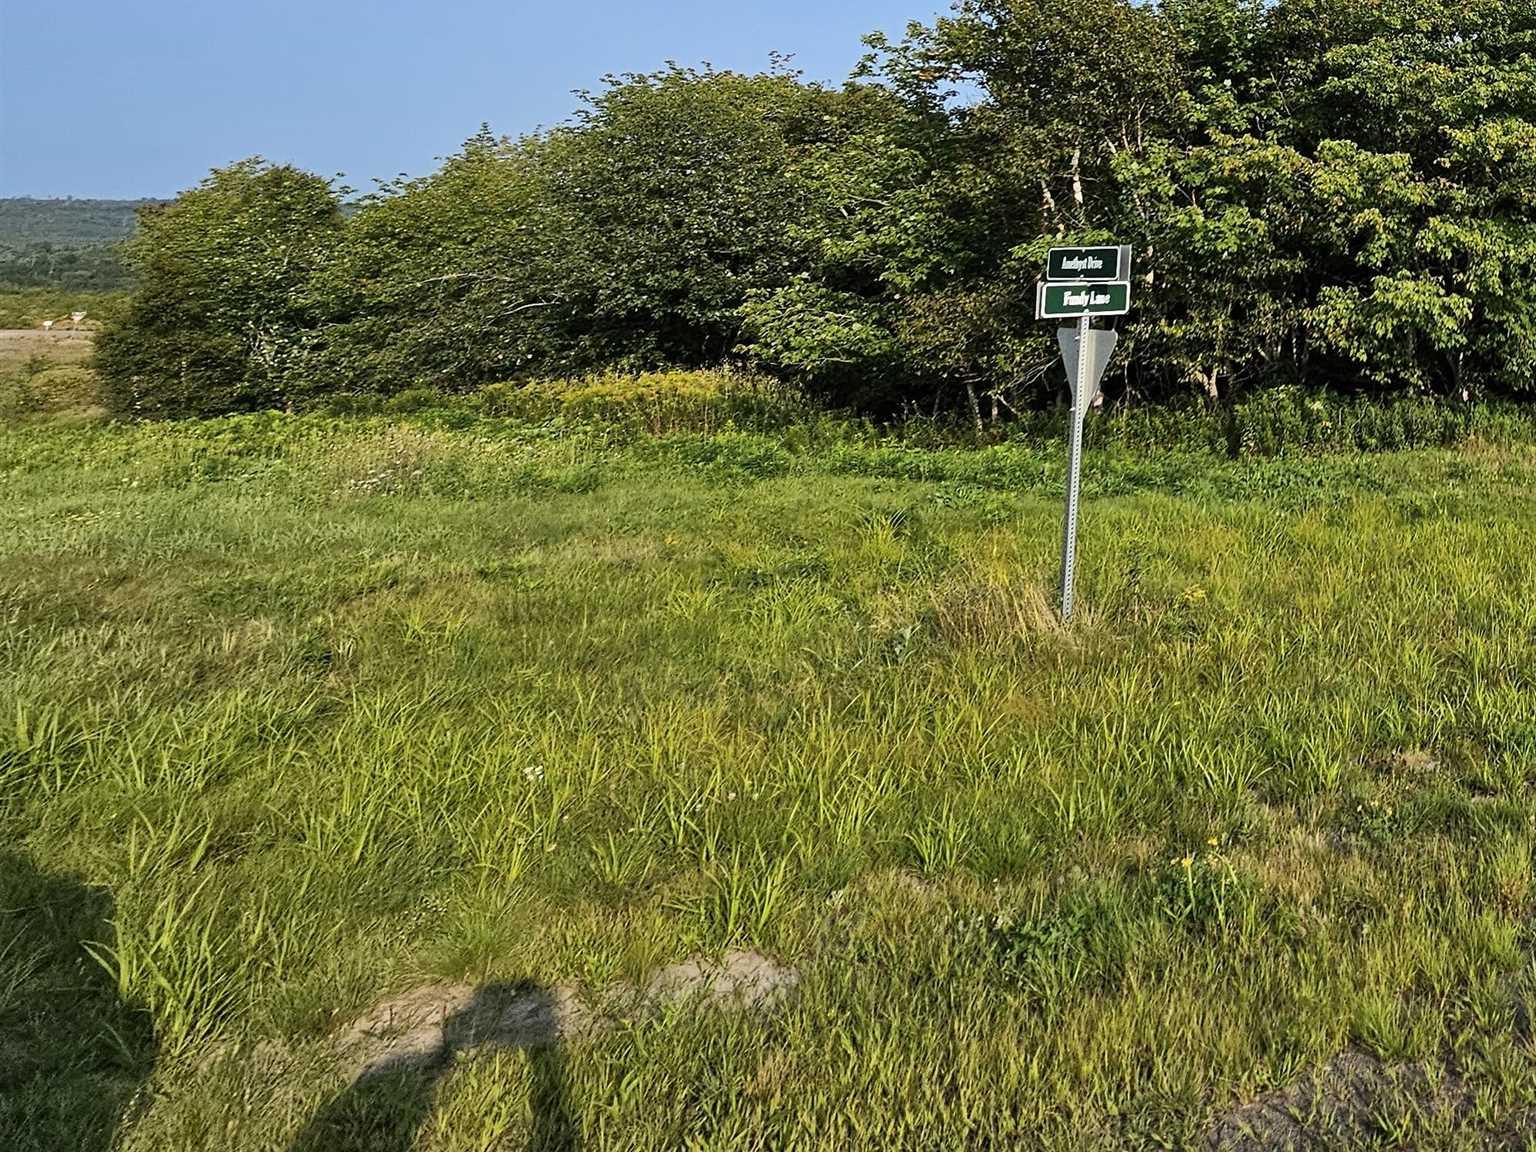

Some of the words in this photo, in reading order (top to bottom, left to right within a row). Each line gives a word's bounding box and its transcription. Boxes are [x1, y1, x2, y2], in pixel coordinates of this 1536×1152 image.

[1087, 256, 1104, 270] Drive
[1063, 291, 1090, 307] Fundy
[1089, 291, 1111, 305] Lane
